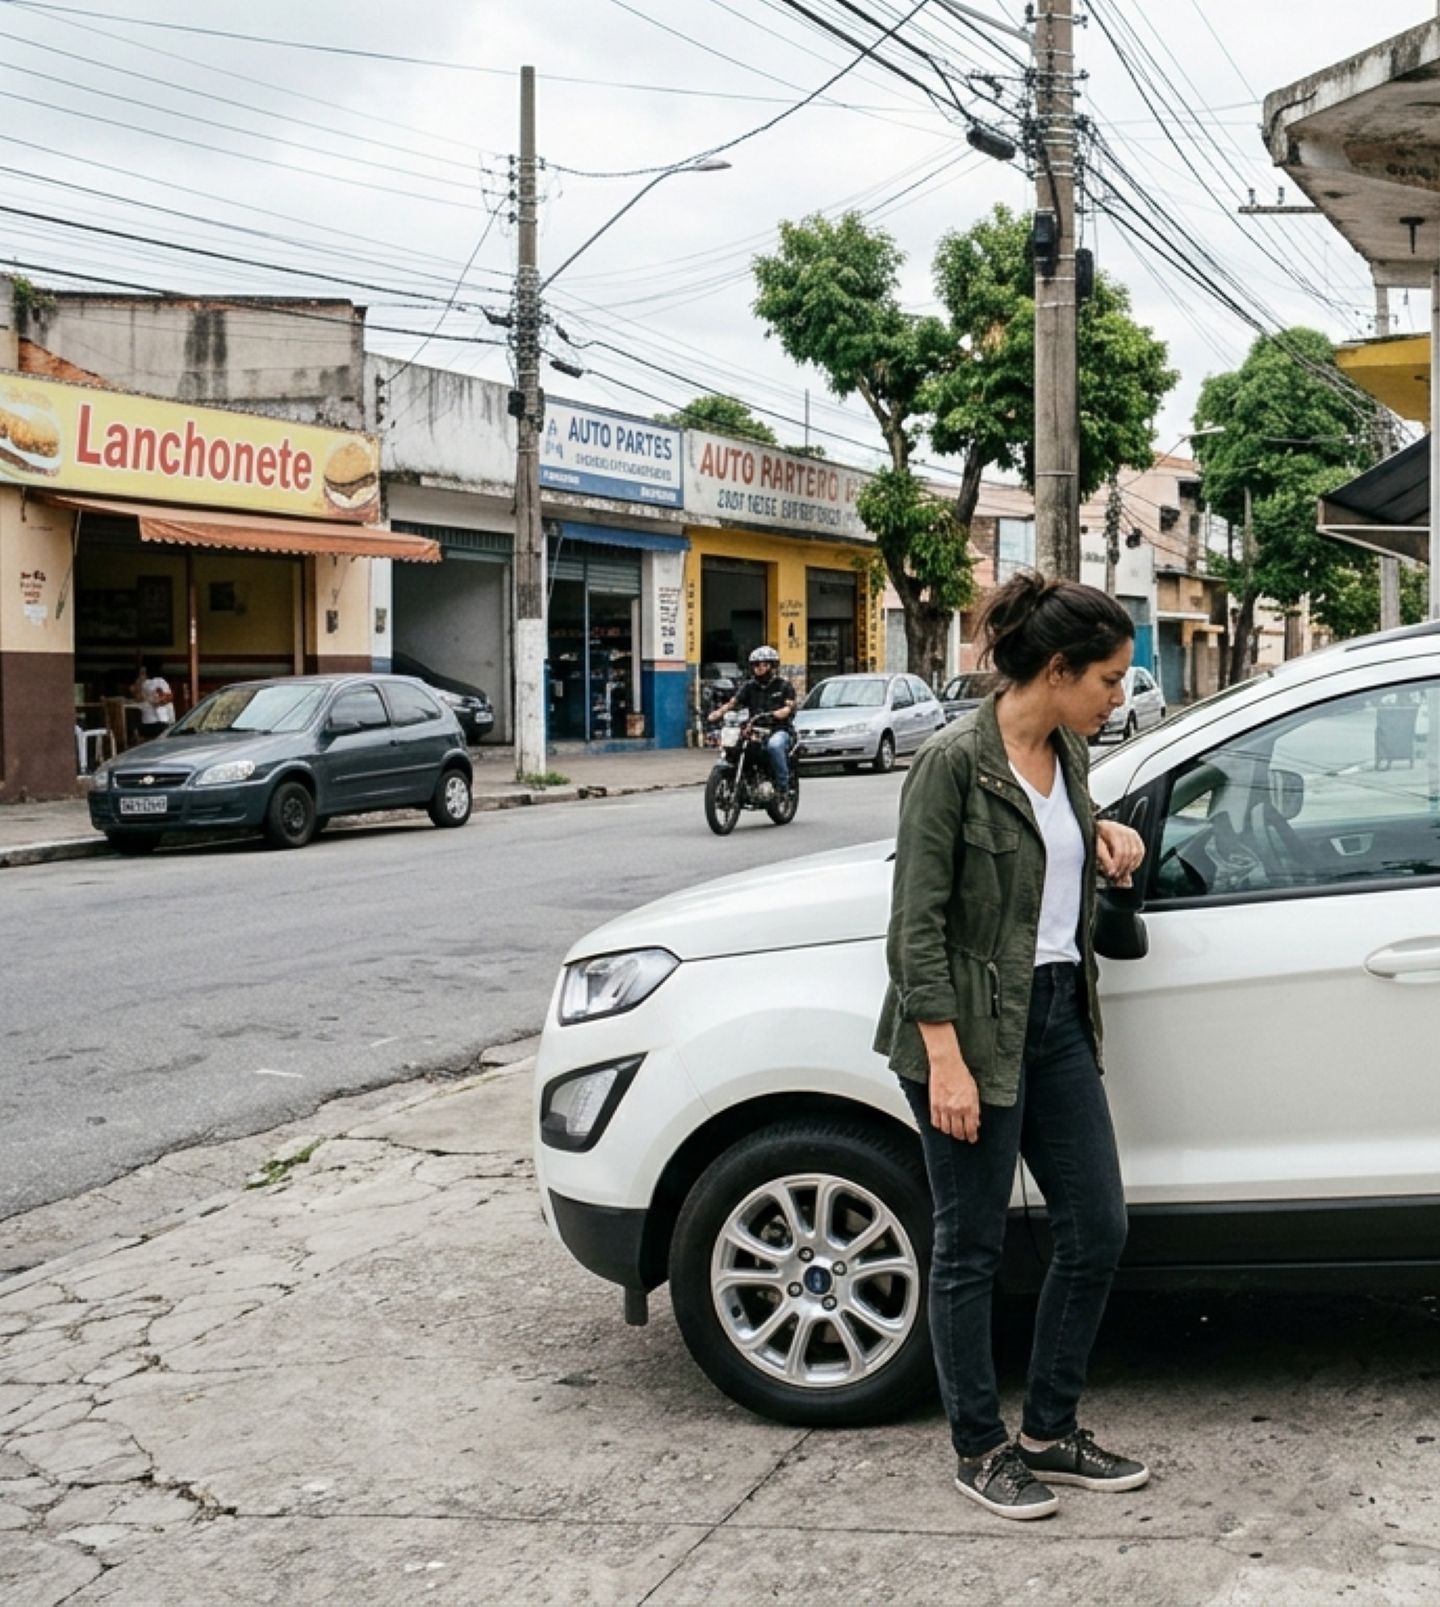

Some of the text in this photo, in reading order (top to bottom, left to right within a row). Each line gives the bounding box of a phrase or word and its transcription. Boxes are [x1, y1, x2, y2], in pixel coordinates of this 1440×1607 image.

[76, 404, 312, 490] Lanchonete
[568, 416, 672, 460] AUTO PARTES
[700, 442, 754, 485] AUTO
